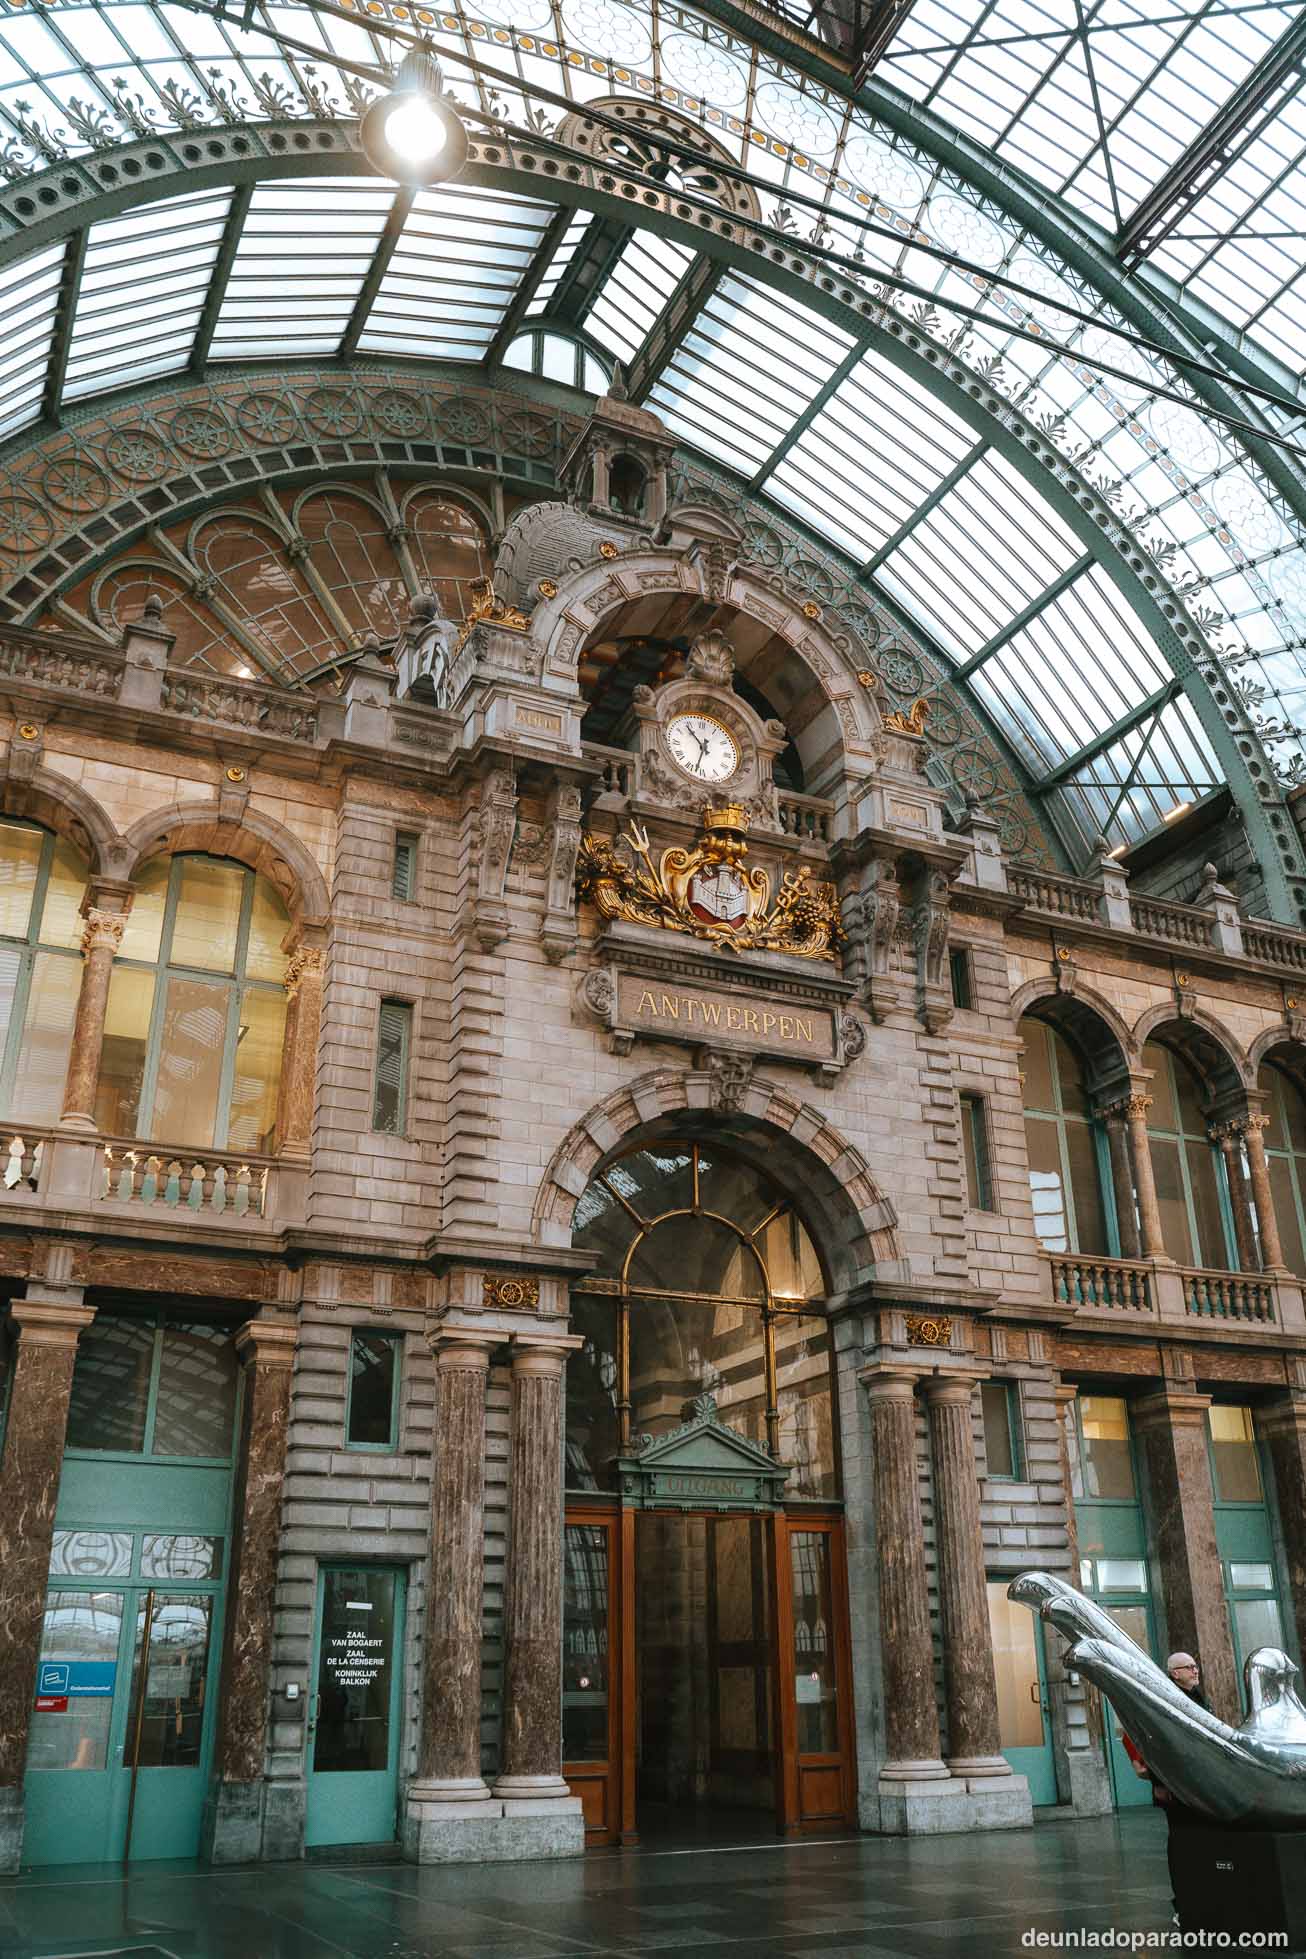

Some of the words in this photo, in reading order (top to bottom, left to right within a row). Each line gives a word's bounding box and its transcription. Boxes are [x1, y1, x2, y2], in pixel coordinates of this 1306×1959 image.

[637, 991, 813, 1042] ANTWERPEN
[346, 1631, 366, 1639] ZAAL
[332, 1639, 347, 1647] VAN
[348, 1639, 383, 1647] BOGAERT
[327, 1657, 337, 1665] DE
[335, 1669, 378, 1677] KONINKLIJK
[340, 1678, 371, 1686] BALKON
